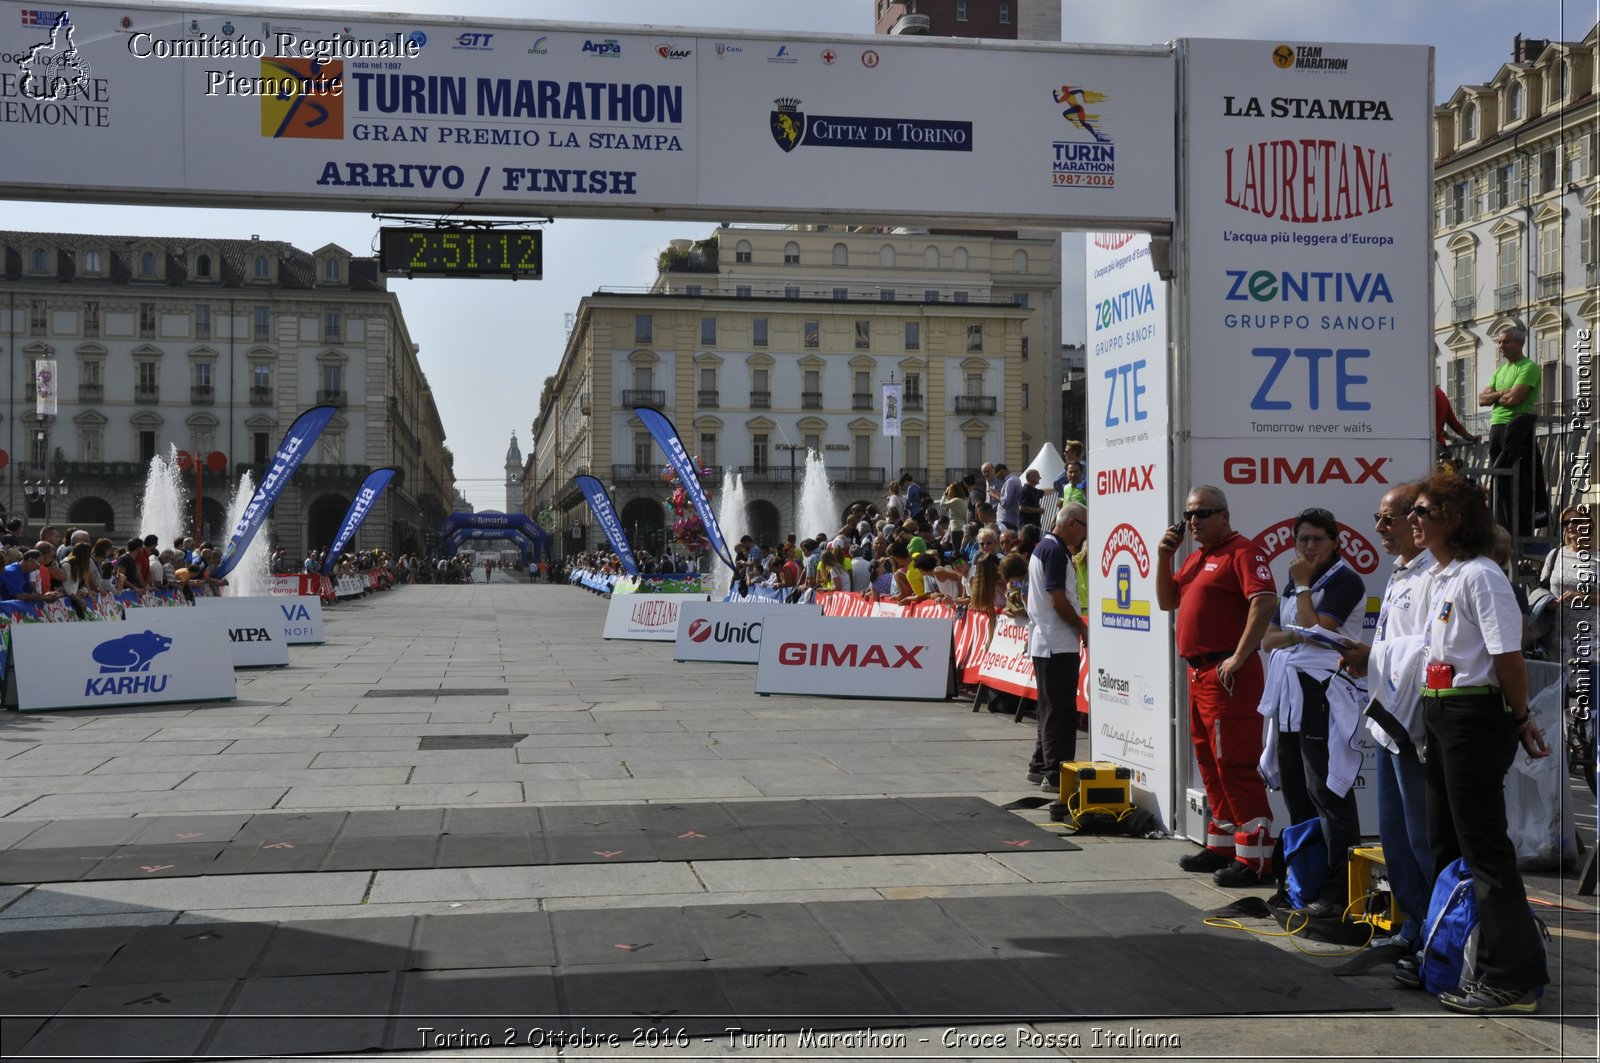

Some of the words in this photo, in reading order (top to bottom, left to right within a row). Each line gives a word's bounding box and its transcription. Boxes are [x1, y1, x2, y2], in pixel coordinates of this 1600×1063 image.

[455, 33, 494, 47] GTT
[726, 45, 742, 53] Coni
[1296, 46, 1322, 58] TEAM
[385, 62, 402, 70] 1897
[669, 50, 693, 58] IAAF
[1295, 58, 1348, 70] MARATHON
[352, 72, 467, 116] TURIN
[476, 77, 683, 123] MARATHON
[1223, 95, 1265, 118] LA
[1270, 96, 1394, 121] STAMPA
[353, 122, 429, 143] GRAN
[437, 126, 540, 147] PREMIO
[548, 131, 581, 148] LA
[589, 132, 684, 151] STAMPA
[874, 125, 893, 142] DI
[897, 122, 966, 144] TORINO
[1052, 143, 1115, 162] TURIN
[316, 161, 465, 190] ARRIVO
[474, 166, 491, 197] /
[502, 167, 637, 195] FINISH
[1053, 161, 1115, 172] MARATHON
[1224, 138, 1394, 224] LAURETANA
[409, 232, 536, 269] 2:51:12
[1223, 230, 1268, 245] L'acqua
[1270, 231, 1288, 245] più
[1292, 232, 1338, 246] leggera
[1340, 232, 1394, 246] d'Europa
[1223, 313, 1310, 330] GRUPPO
[1320, 315, 1395, 331] SANOFI
[1095, 335, 1124, 357] GRUPPO
[1126, 323, 1156, 347] SANOFI
[1250, 347, 1372, 411] ZTE
[1104, 358, 1148, 429] ZTE
[1250, 421, 1305, 433] Tomorrow
[1308, 423, 1340, 433] never
[1343, 421, 1373, 433] waits
[272, 466, 293, 498] Premium
[1097, 463, 1155, 497] GIMAX
[1223, 456, 1390, 485] GIMAX
[235, 435, 303, 539] Bavaria
[333, 486, 376, 553] Bavaria
[1102, 525, 1149, 573] TAPPOROSSO
[631, 600, 678, 627] LAURETANA
[1136, 617, 1149, 630] Torino
[714, 620, 761, 644] UniC
[778, 641, 924, 670] GIMAX
[84, 673, 168, 697] KARHU
[1098, 668, 1130, 693] Tailorsan
[1143, 694, 1154, 705] Gest
[1101, 722, 1155, 757] Mirafiori
